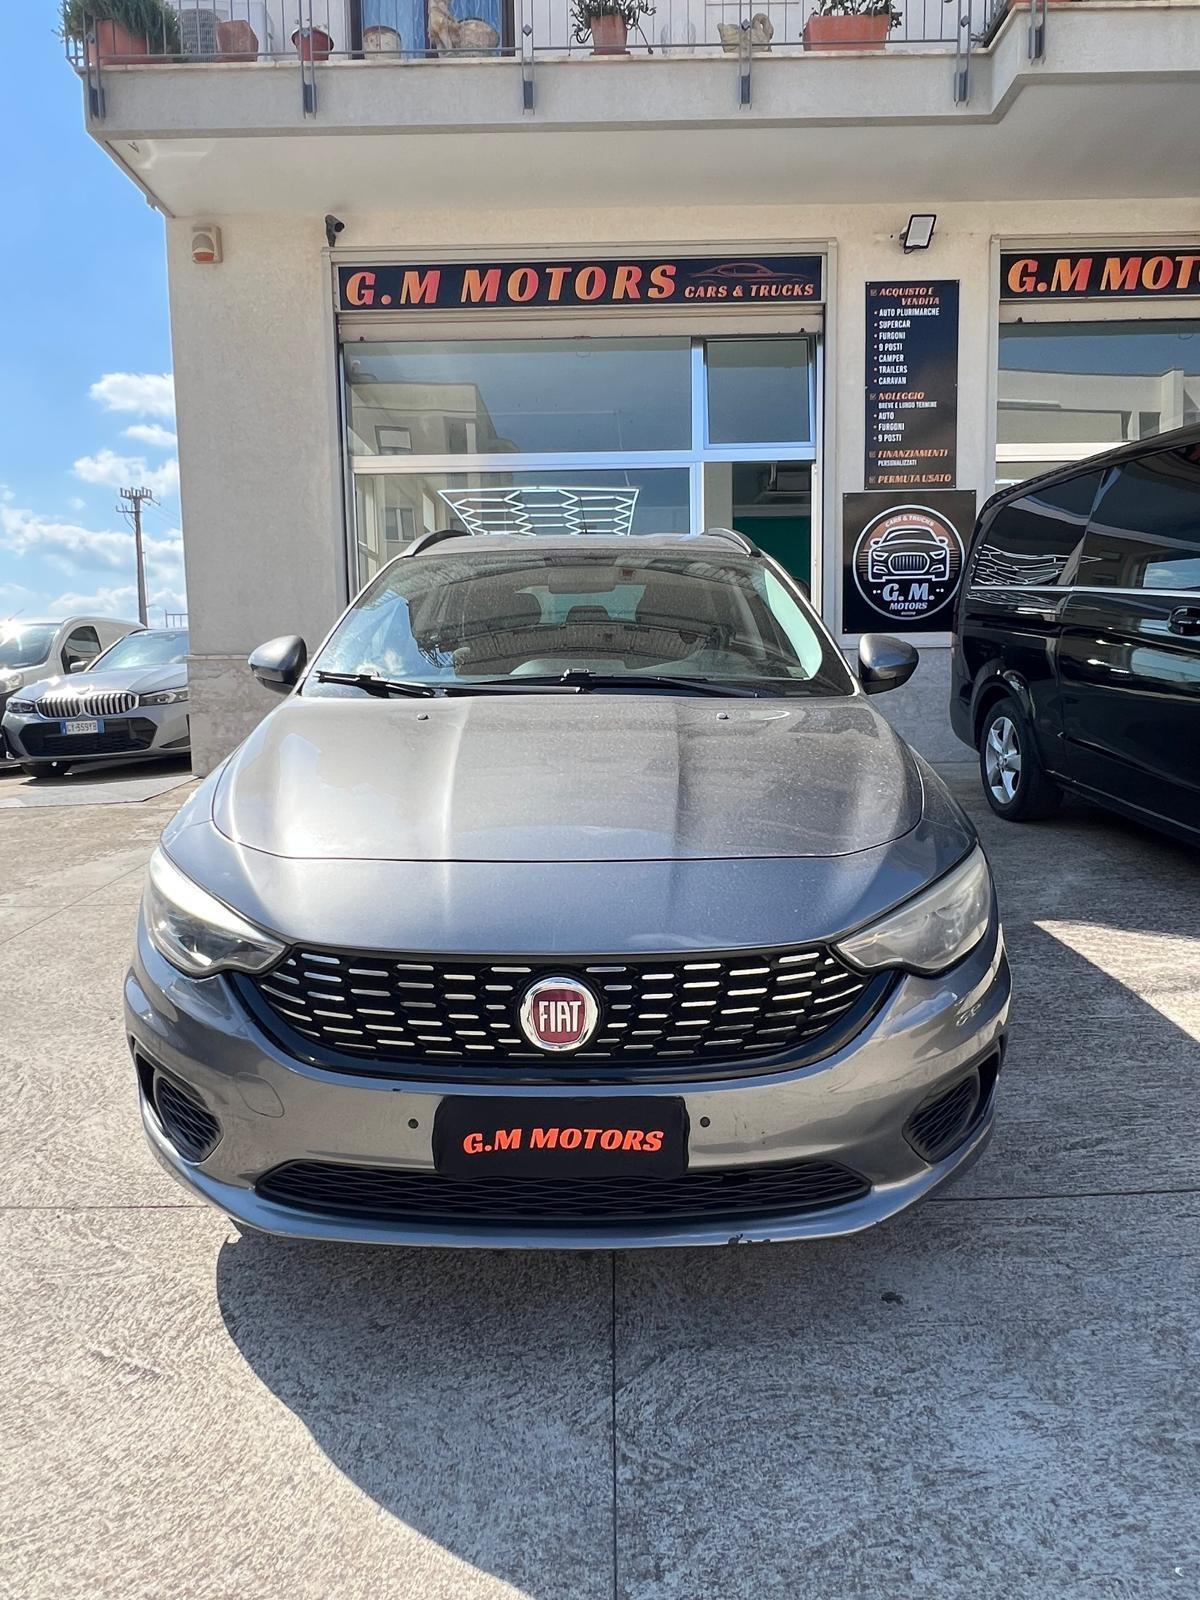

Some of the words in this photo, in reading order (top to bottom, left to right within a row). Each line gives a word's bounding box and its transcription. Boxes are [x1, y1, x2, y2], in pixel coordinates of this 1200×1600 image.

[1007, 257, 1093, 293] G.M
[1100, 256, 1200, 290] MOT
[346, 271, 440, 305] G.M
[460, 265, 677, 304] MOTORS
[684, 285, 728, 298] CARS
[732, 285, 744, 297] &
[750, 283, 814, 297] TRUCKS
[880, 287, 926, 296] ACQUISTO
[901, 297, 939, 305] VENDITA
[896, 307, 940, 316] PLURIMARCHE
[879, 320, 911, 329] SUPERCAR
[879, 332, 906, 340] FURGONI
[879, 344, 884, 352] 9
[884, 343, 903, 351] POSTI
[878, 354, 904, 363] CAMPER
[878, 365, 908, 374] TRAILERS
[878, 376, 907, 385] CARAVAN
[878, 392, 925, 400] NOLEGGIO
[878, 411, 895, 420] AUTO
[878, 423, 905, 431] FURGONI
[877, 434, 883, 442] 9
[883, 433, 902, 442] POSTI
[877, 449, 948, 458] FINANZIAMENTI
[877, 475, 921, 483] PERMUTA
[921, 474, 952, 482] USATO
[889, 602, 928, 610] MOTORS
[538, 1001, 582, 1033] FIAT
[463, 1129, 522, 1154] G.M
[529, 1128, 665, 1152] MOTORS
